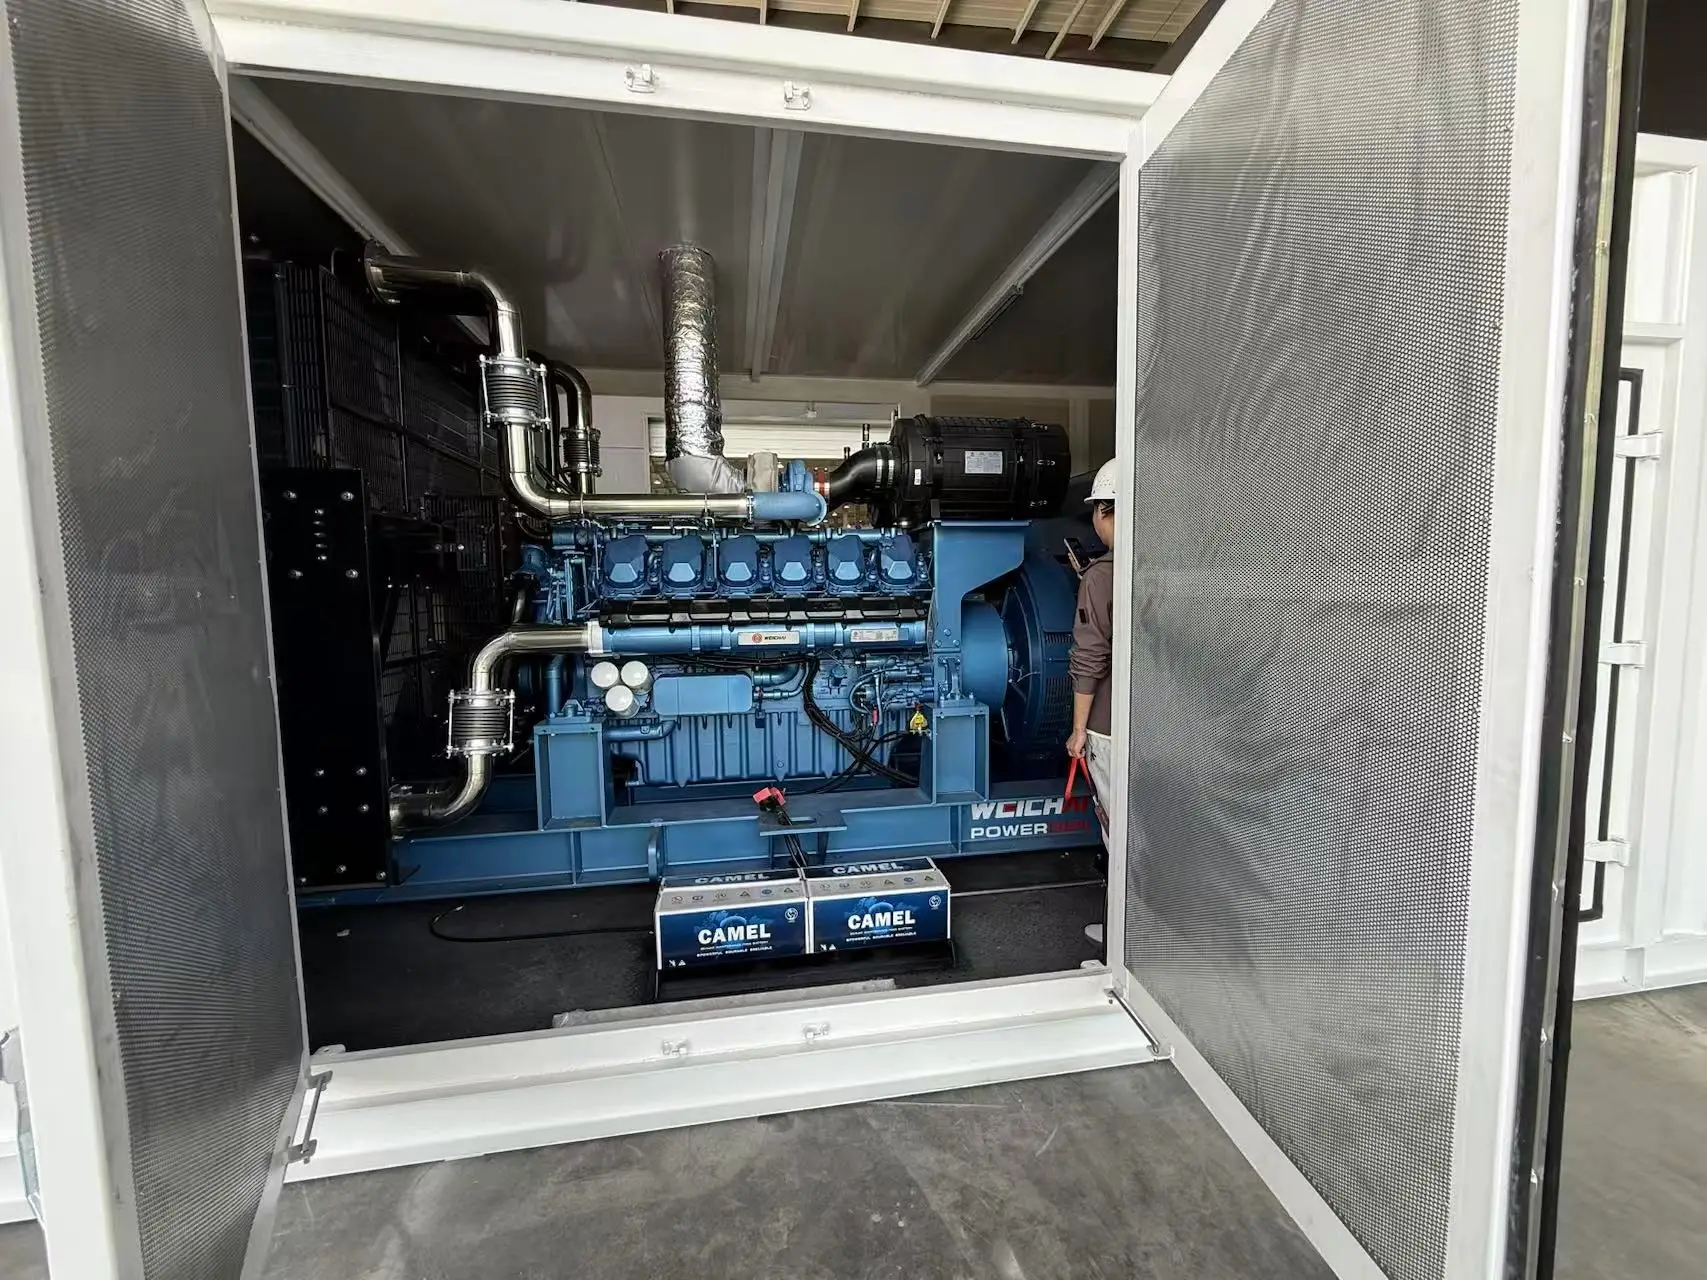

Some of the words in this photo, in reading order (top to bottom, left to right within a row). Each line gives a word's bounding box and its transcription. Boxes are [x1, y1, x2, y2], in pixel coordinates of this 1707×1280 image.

[971, 823, 1047, 838] POWER
[832, 862, 903, 874] CAMEL
[695, 873, 769, 884] CAMEL
[848, 910, 915, 929] CAMEL
[698, 924, 770, 944] CAMEL
